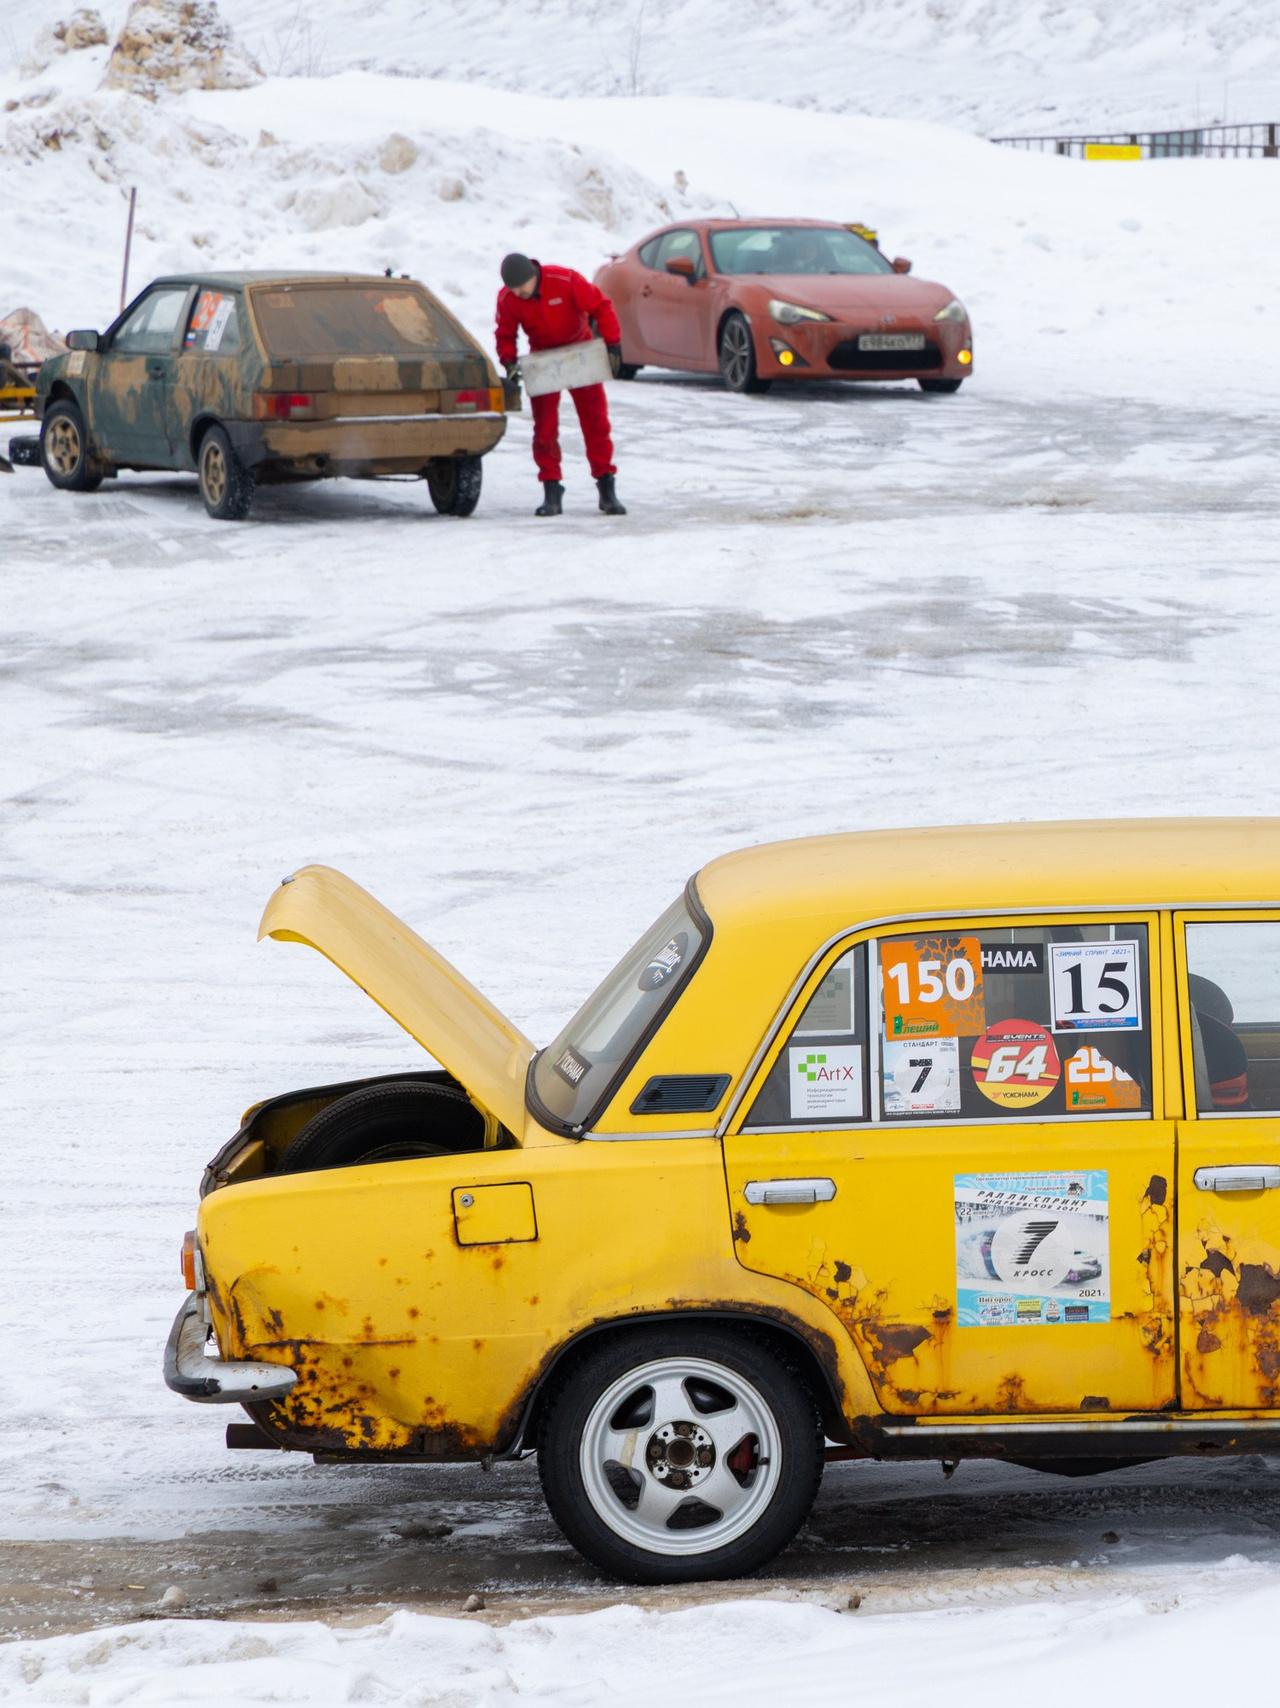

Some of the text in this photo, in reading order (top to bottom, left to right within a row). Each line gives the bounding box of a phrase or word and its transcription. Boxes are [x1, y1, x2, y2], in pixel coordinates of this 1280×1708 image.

[888, 958, 975, 1004] 150
[1062, 962, 1130, 1014] 15
[909, 1058, 933, 1093] 7
[984, 1044, 1049, 1083] 64
[1033, 1195, 1088, 1207] СПРИНТ
[1010, 1221, 1059, 1264] 7
[1014, 1269, 1054, 1277] КРОСС
[1079, 1289, 1101, 1297] 2021
